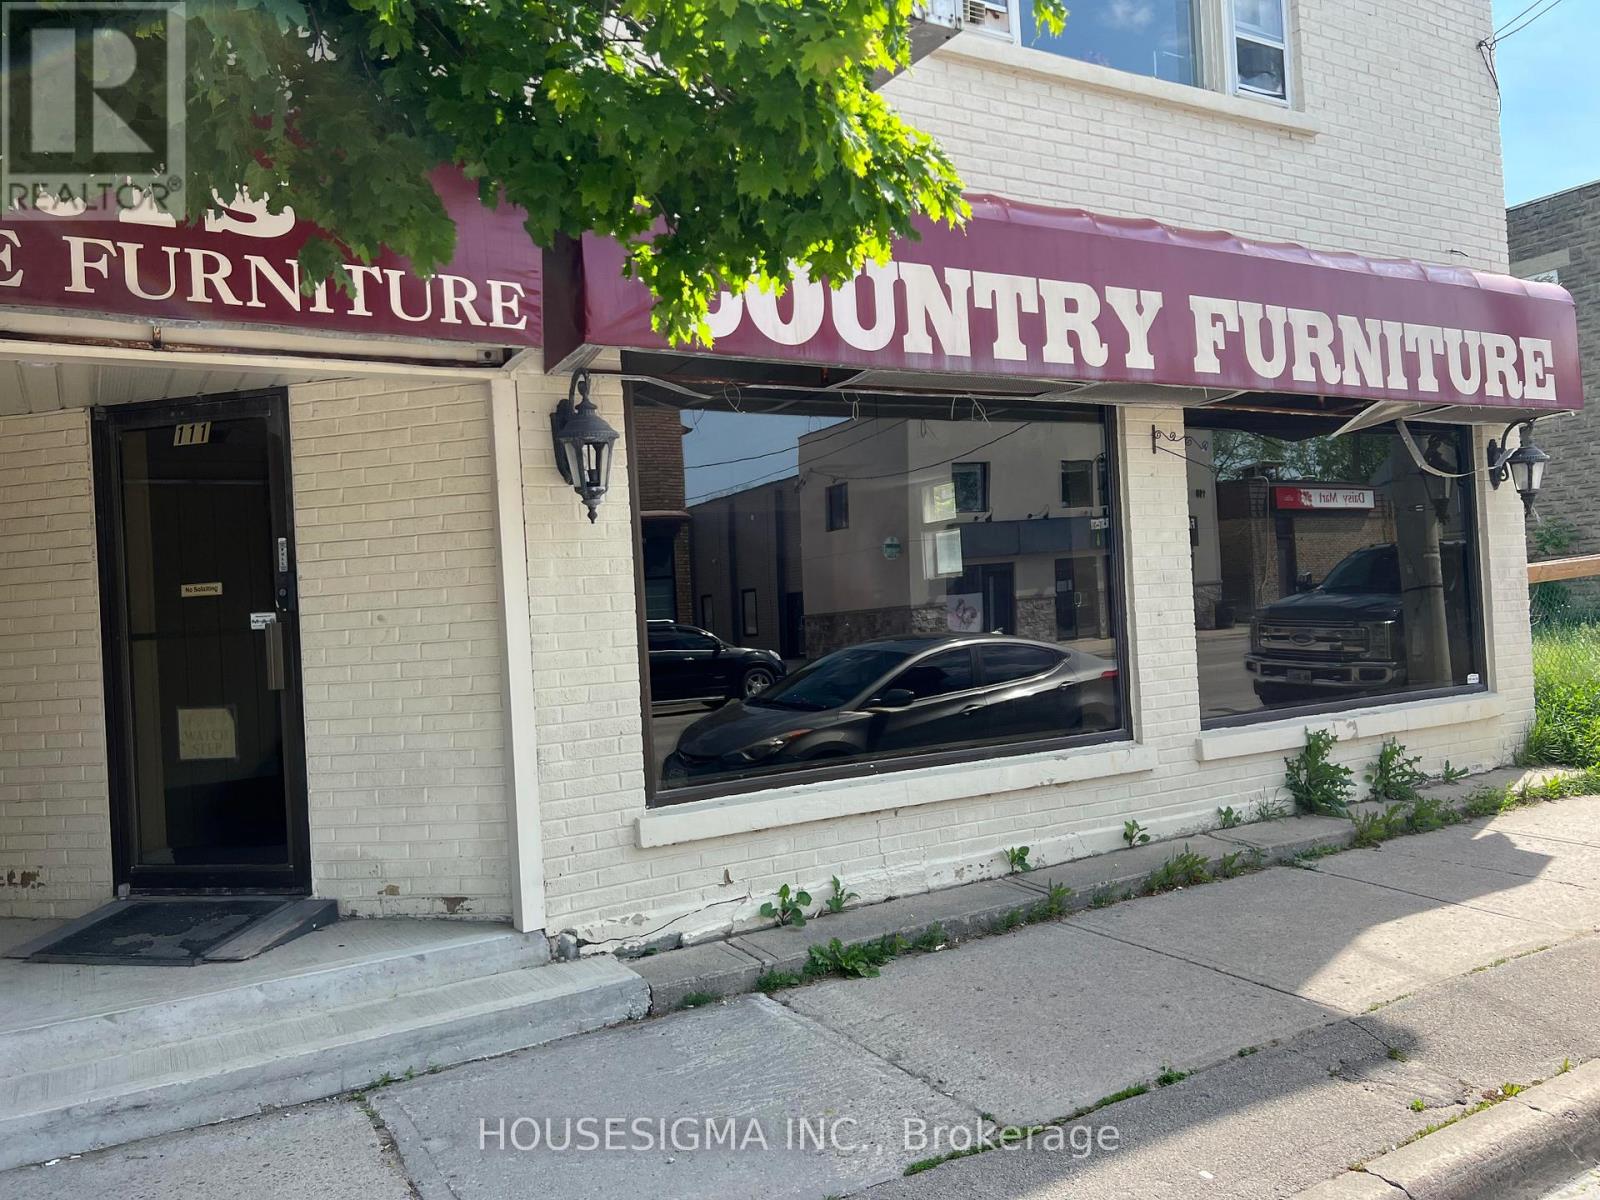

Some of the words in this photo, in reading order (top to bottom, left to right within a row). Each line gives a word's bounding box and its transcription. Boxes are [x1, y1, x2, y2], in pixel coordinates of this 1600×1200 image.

[61, 235, 528, 331] FURNITURE
[1189, 294, 1556, 401] FURNITURE
[177, 422, 207, 444] 111
